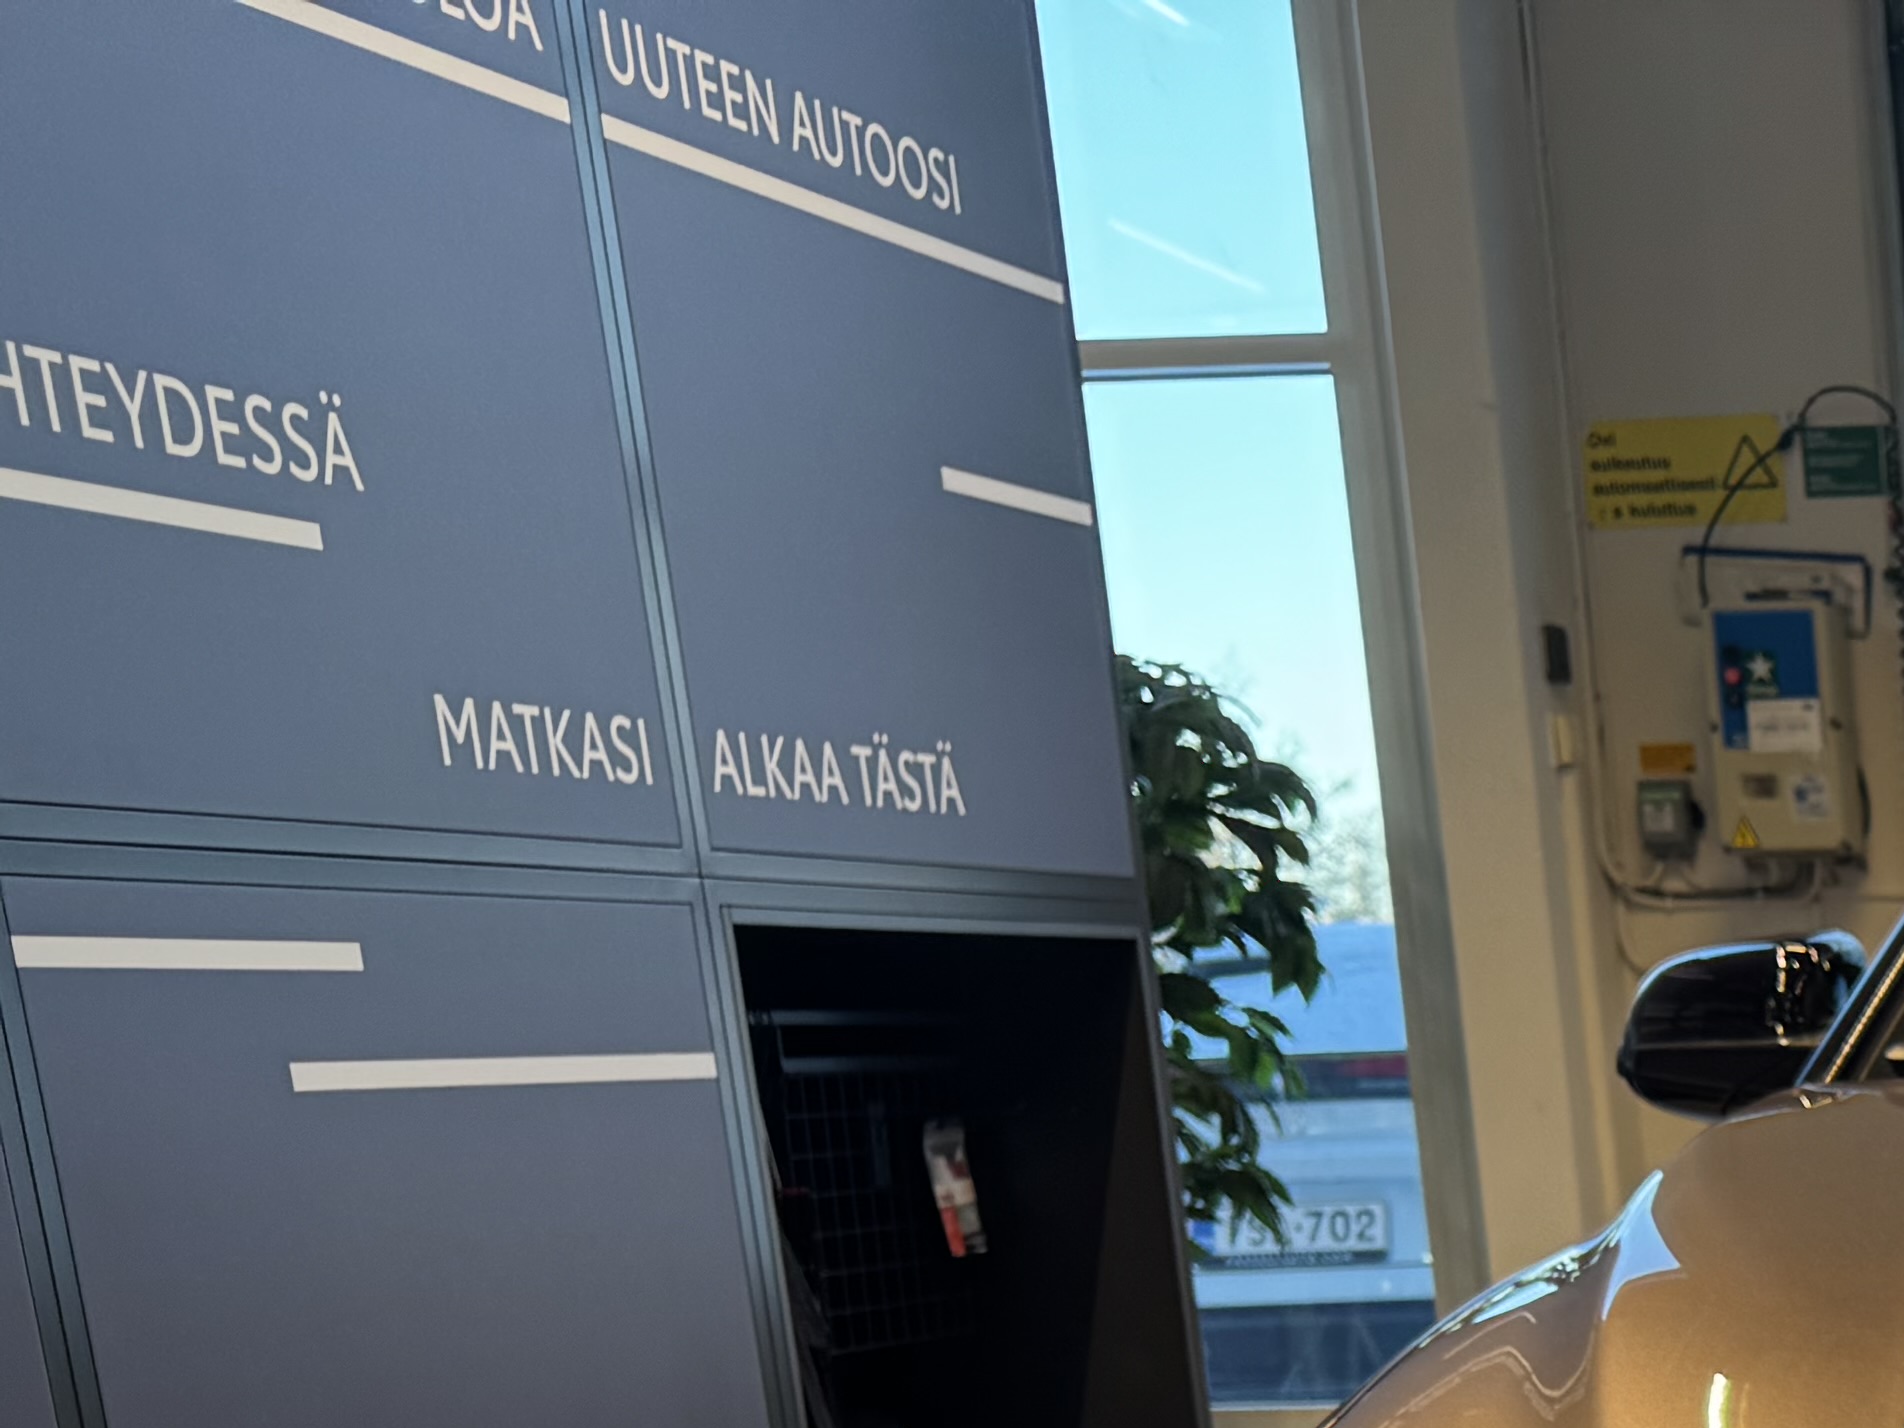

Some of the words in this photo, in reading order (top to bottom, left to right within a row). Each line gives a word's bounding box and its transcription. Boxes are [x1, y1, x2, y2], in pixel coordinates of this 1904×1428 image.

[598, 8, 780, 145] UUTEEN
[791, 90, 962, 215] AUTOOSI
[433, 693, 653, 786] MATKASI
[713, 728, 849, 806] ALKAA
[850, 732, 966, 816] TÄSTÄ
